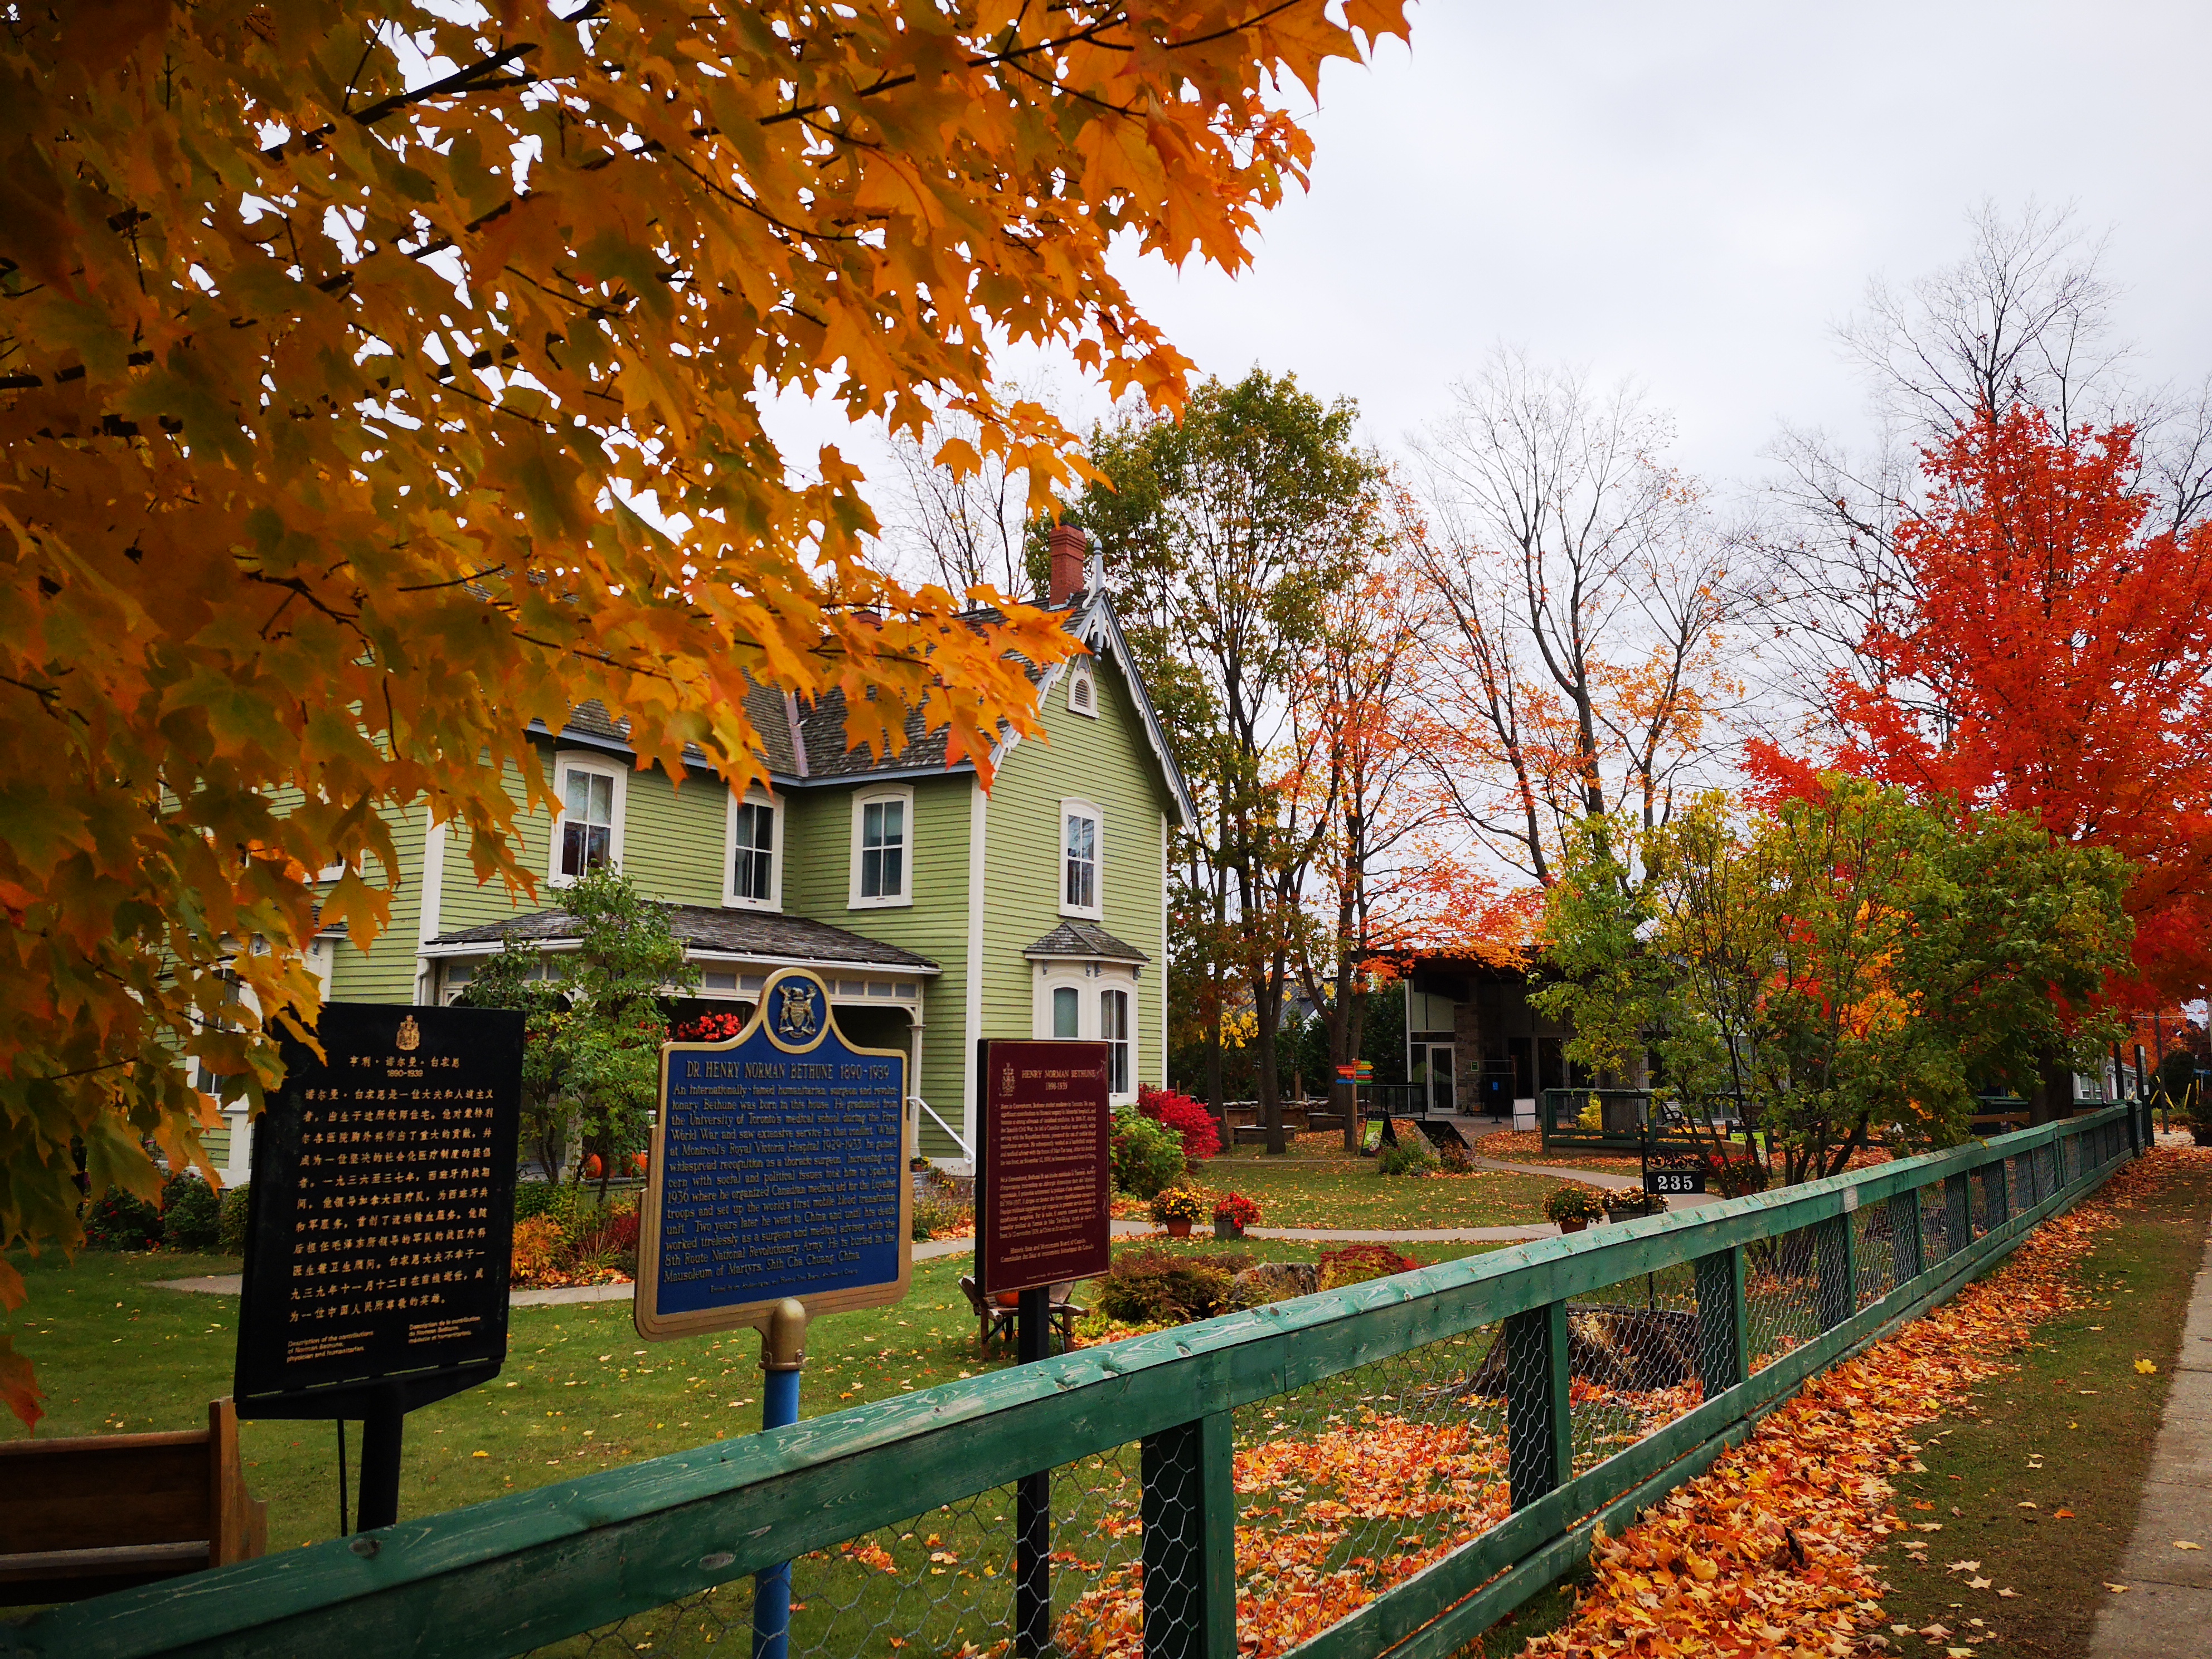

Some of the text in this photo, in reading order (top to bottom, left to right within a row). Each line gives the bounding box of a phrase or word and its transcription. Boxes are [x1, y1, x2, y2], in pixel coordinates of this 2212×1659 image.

[686, 1060, 702, 1078] DR.
[705, 1061, 740, 1078] HENRY
[745, 1062, 785, 1079] NORMAN
[790, 1064, 833, 1079] BETHUNE
[1022, 1070, 1042, 1079] HENRY
[1044, 1070, 1069, 1078] NORMAN
[672, 1083, 686, 1095] An
[704, 1099, 736, 1110] Bethune
[740, 1102, 755, 1110] was
[759, 1099, 777, 1110] born
[779, 1100, 788, 1110] in
[671, 1114, 685, 1126] the
[690, 1111, 734, 1127] University
[736, 1113, 744, 1124] of
[671, 1129, 696, 1141] World
[700, 1128, 719, 1140] War
[721, 1128, 736, 1139] and
[757, 1128, 793, 1138] extensive
[670, 1146, 678, 1156] at
[682, 1143, 725, 1156] Montreal's
[729, 1143, 751, 1156] Royal
[754, 1141, 785, 1153] Victoria
[669, 1160, 717, 1174] widespread
[720, 1158, 763, 1171] recognition
[668, 1178, 687, 1188] cern
[692, 1175, 712, 1186] with
[716, 1172, 741, 1185] social
[745, 1172, 760, 1183] and
[764, 1171, 795, 1184] political
[798, 1170, 822, 1180] issues
[1657, 1175, 1693, 1190] 235
[667, 1188, 690, 1204] 1936
[692, 1190, 717, 1202] where
[719, 1189, 729, 1200] he
[731, 1186, 769, 1201] organized
[772, 1185, 806, 1195] Canadian
[808, 1182, 834, 1193] medical
[667, 1209, 695, 1221] troops
[698, 1205, 714, 1216] and
[716, 1205, 730, 1215] set
[733, 1204, 744, 1217] up
[747, 1201, 760, 1212] the
[762, 1200, 791, 1211] world's
[793, 1199, 811, 1209] first
[695, 1220, 711, 1233] Two
[714, 1221, 738, 1234] years
[740, 1217, 759, 1229] later
[761, 1216, 771, 1226] he
[773, 1215, 792, 1225] went
[794, 1214, 801, 1224] to
[804, 1211, 827, 1223] China
[828, 1210, 842, 1220] and
[664, 1236, 697, 1251] worked
[701, 1233, 739, 1248] tirelessly
[741, 1235, 751, 1243] as
[761, 1231, 791, 1243] surgeon
[793, 1226, 808, 1238] and
[810, 1224, 837, 1235] medical
[664, 1254, 681, 1267] 8th
[685, 1253, 709, 1264] Route
[711, 1247, 745, 1262] National
[749, 1245, 800, 1255] Revolutionary
[828, 1237, 838, 1248] He
[841, 1238, 848, 1247] is
[664, 1268, 712, 1283] Mausoleum
[716, 1265, 724, 1277] of
[766, 1258, 784, 1270] Shih
